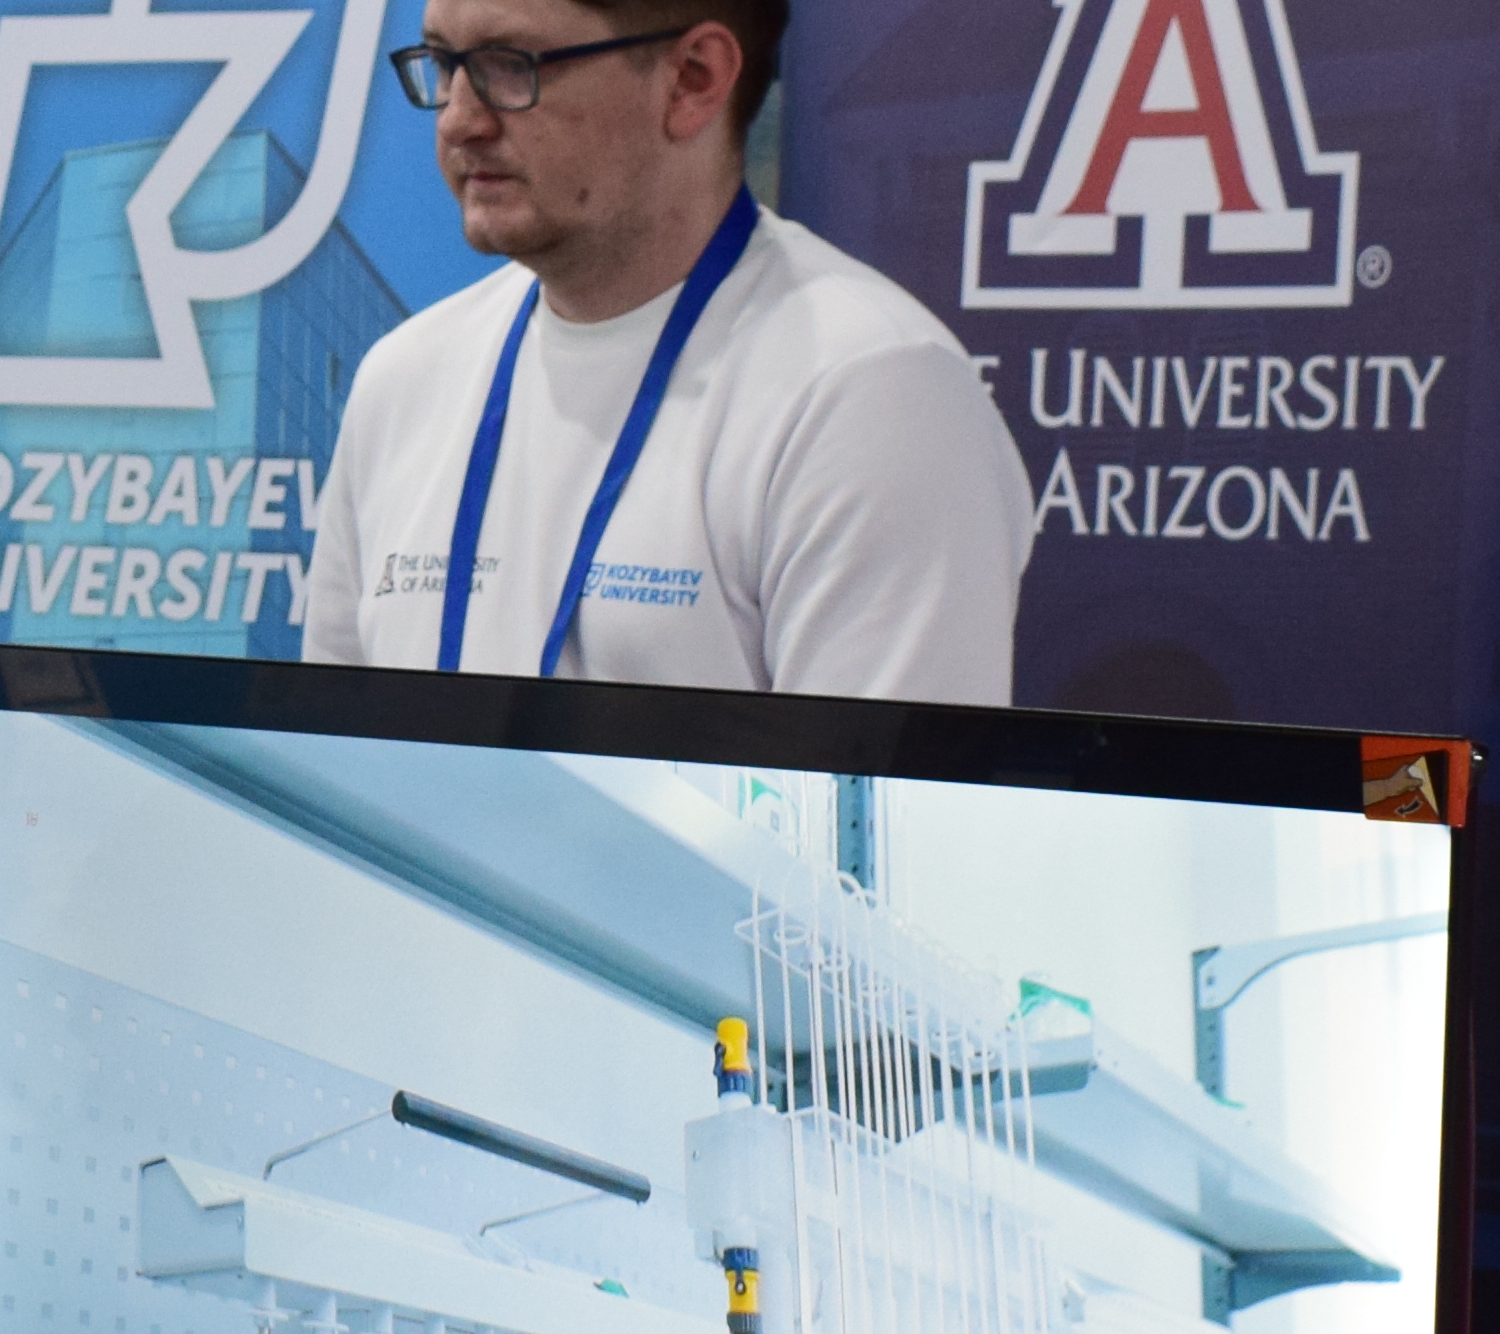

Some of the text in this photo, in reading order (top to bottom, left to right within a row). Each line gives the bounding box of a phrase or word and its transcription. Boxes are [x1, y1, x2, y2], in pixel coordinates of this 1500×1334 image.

[1030, 348, 1445, 431] UNIVERSITY
[1034, 447, 1371, 543] ARIZONA
[600, 585, 700, 607] UNIVERSITY
[607, 564, 703, 586] KOZYBAYEV
